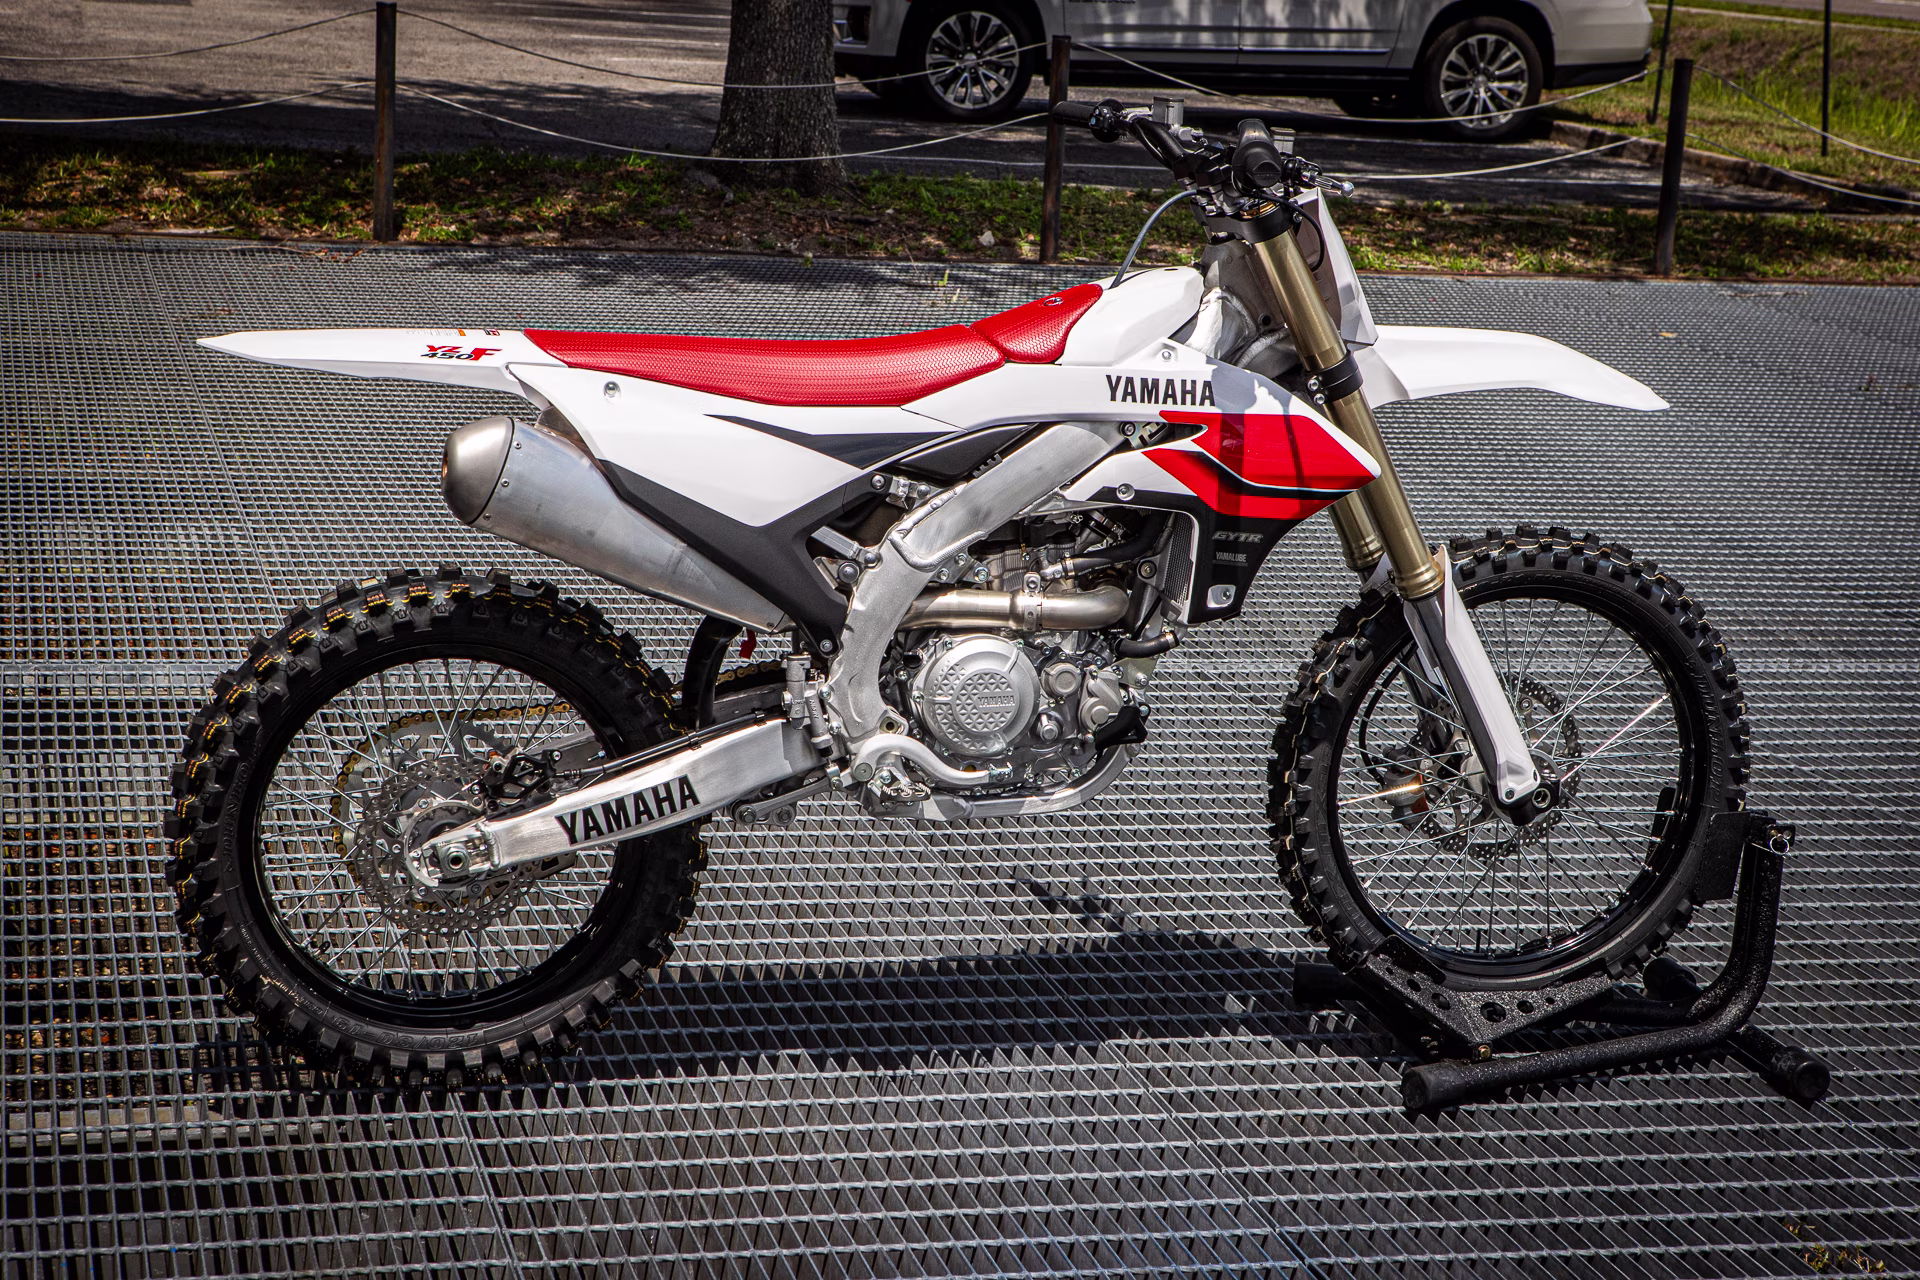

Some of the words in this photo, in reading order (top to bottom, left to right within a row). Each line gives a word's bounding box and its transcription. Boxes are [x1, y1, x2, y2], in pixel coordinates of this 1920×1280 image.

[426, 345, 463, 353] YZ
[421, 352, 475, 360] 450
[1105, 374, 1217, 407] YAMAHA
[1212, 531, 1264, 543] GYTR
[1215, 552, 1248, 563] YAMALUBE
[978, 695, 1015, 707] YAMAHA
[554, 775, 701, 847] YAMAHA
